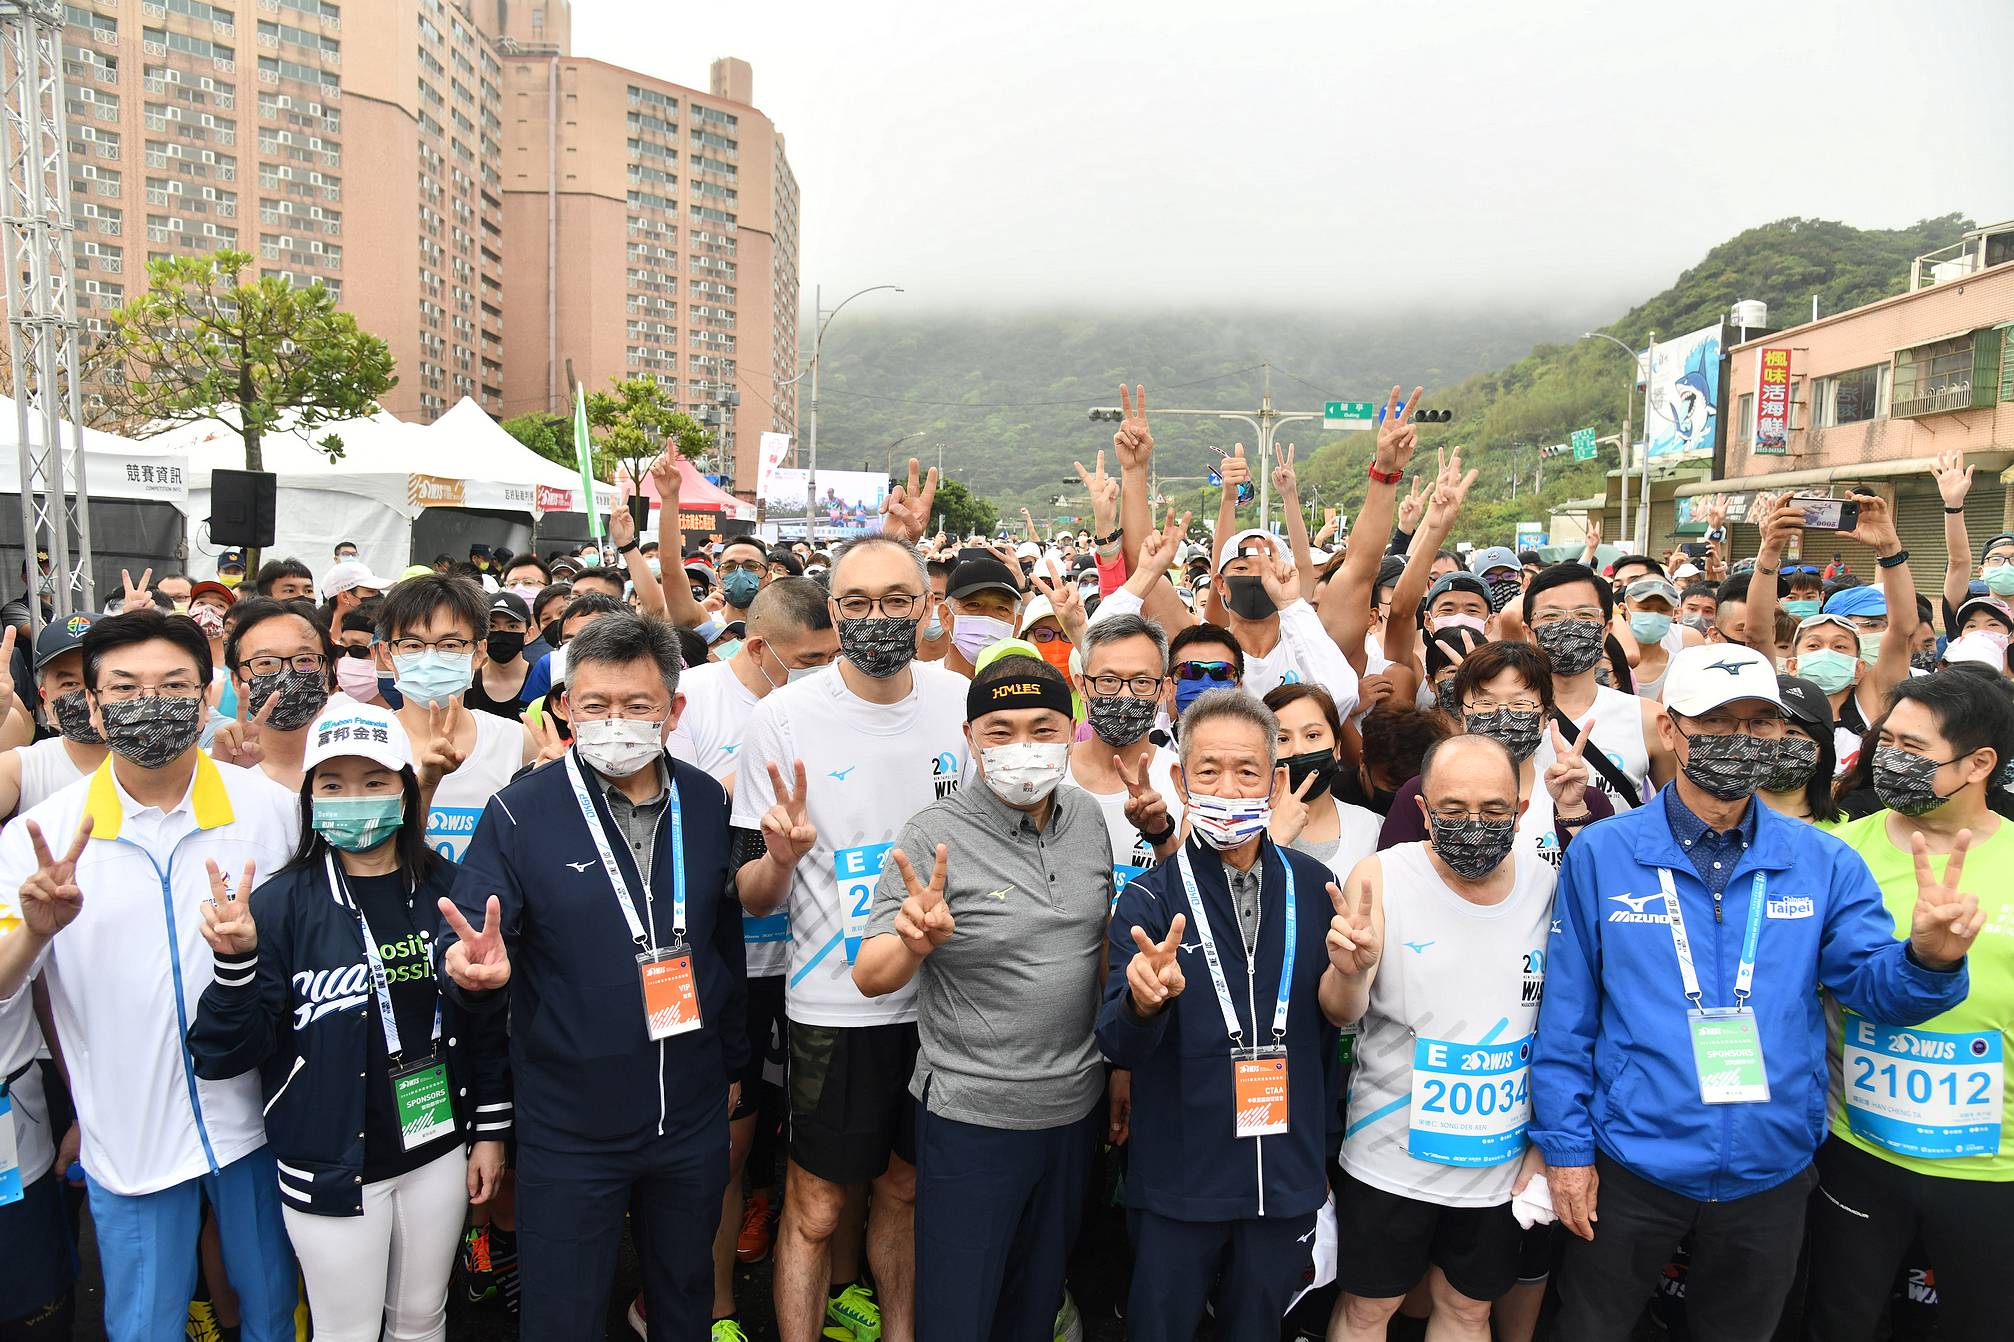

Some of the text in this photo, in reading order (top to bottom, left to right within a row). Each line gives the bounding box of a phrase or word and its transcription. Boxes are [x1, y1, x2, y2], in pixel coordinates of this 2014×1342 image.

[1760, 350, 1788, 435] 楓味活海鮮
[126, 464, 182, 484] 競賽資訊
[318, 726, 388, 748] 富邦金控
[846, 852, 865, 873] E
[1770, 902, 1810, 916] Taipei
[679, 983, 691, 992] VIP
[1858, 1020, 1876, 1046] E
[1427, 1043, 1448, 1068] E
[1264, 1086, 1284, 1095] CTAA
[1854, 1055, 1991, 1106] 21012
[406, 1088, 446, 1109] SPONSORS
[1421, 1072, 1529, 1117] 20034
